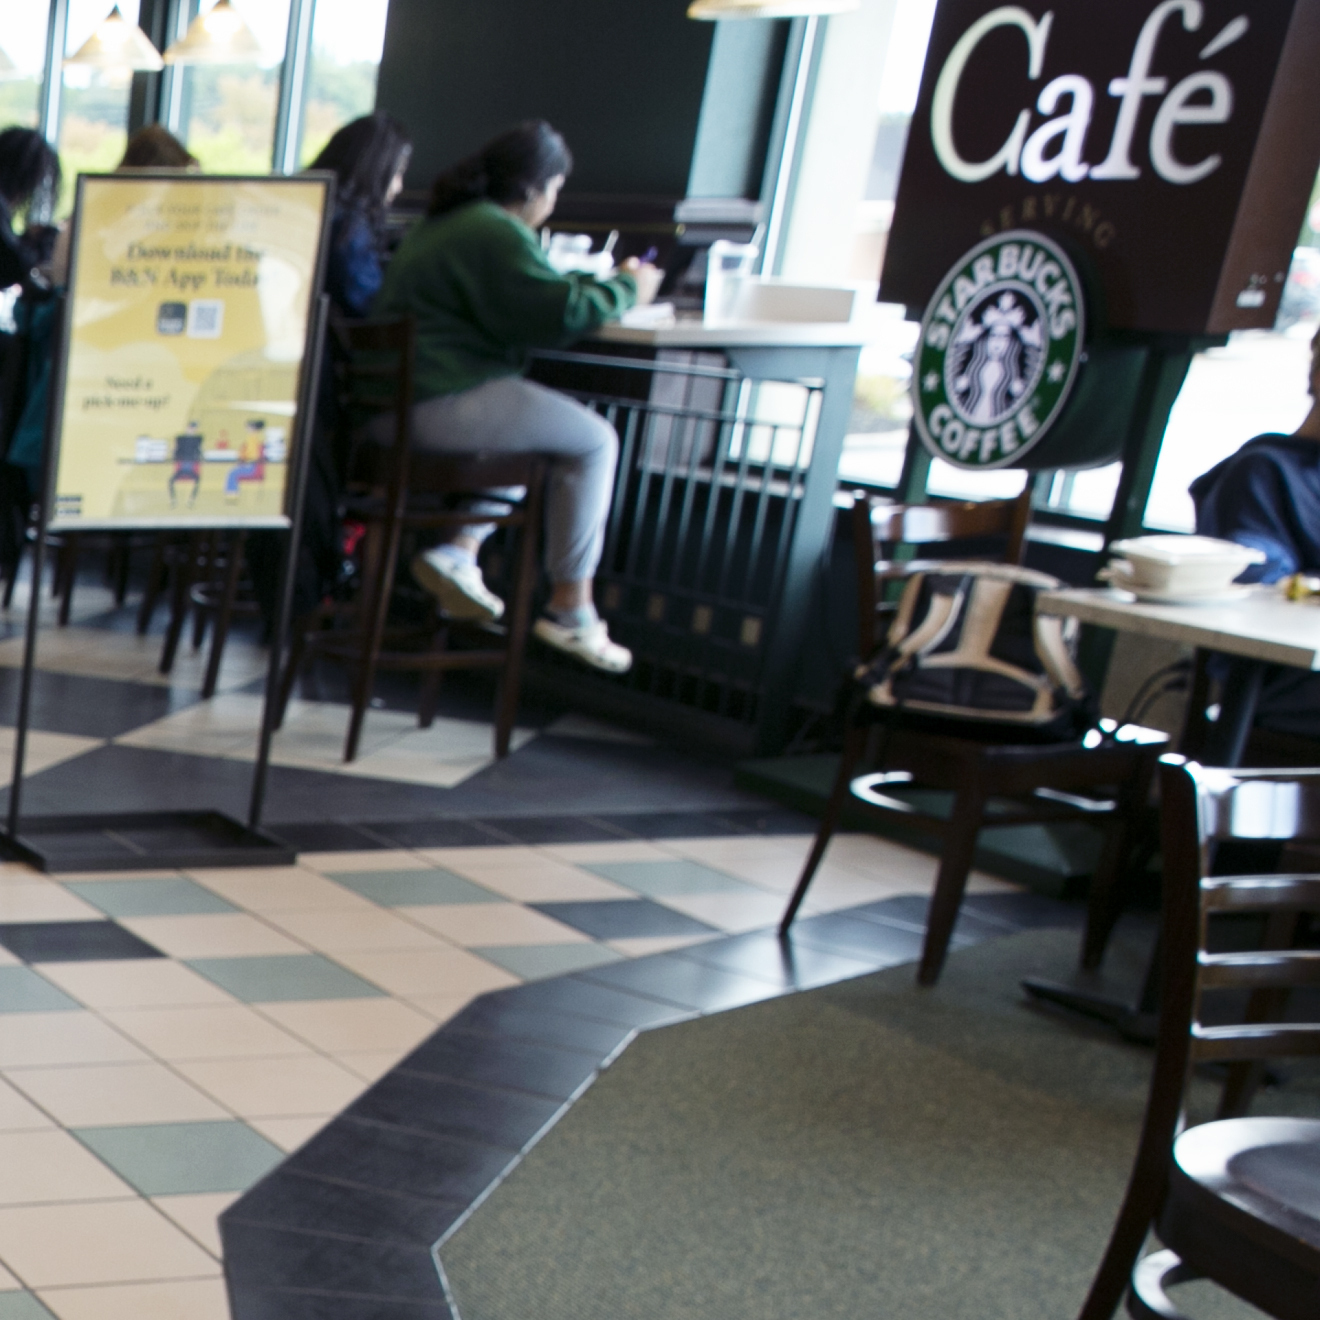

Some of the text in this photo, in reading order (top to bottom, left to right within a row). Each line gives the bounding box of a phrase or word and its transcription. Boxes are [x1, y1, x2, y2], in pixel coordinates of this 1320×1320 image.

[931, 0, 1250, 184] Café
[927, 243, 1077, 350] STARBUCKS
[927, 402, 1041, 463] COFFEE
